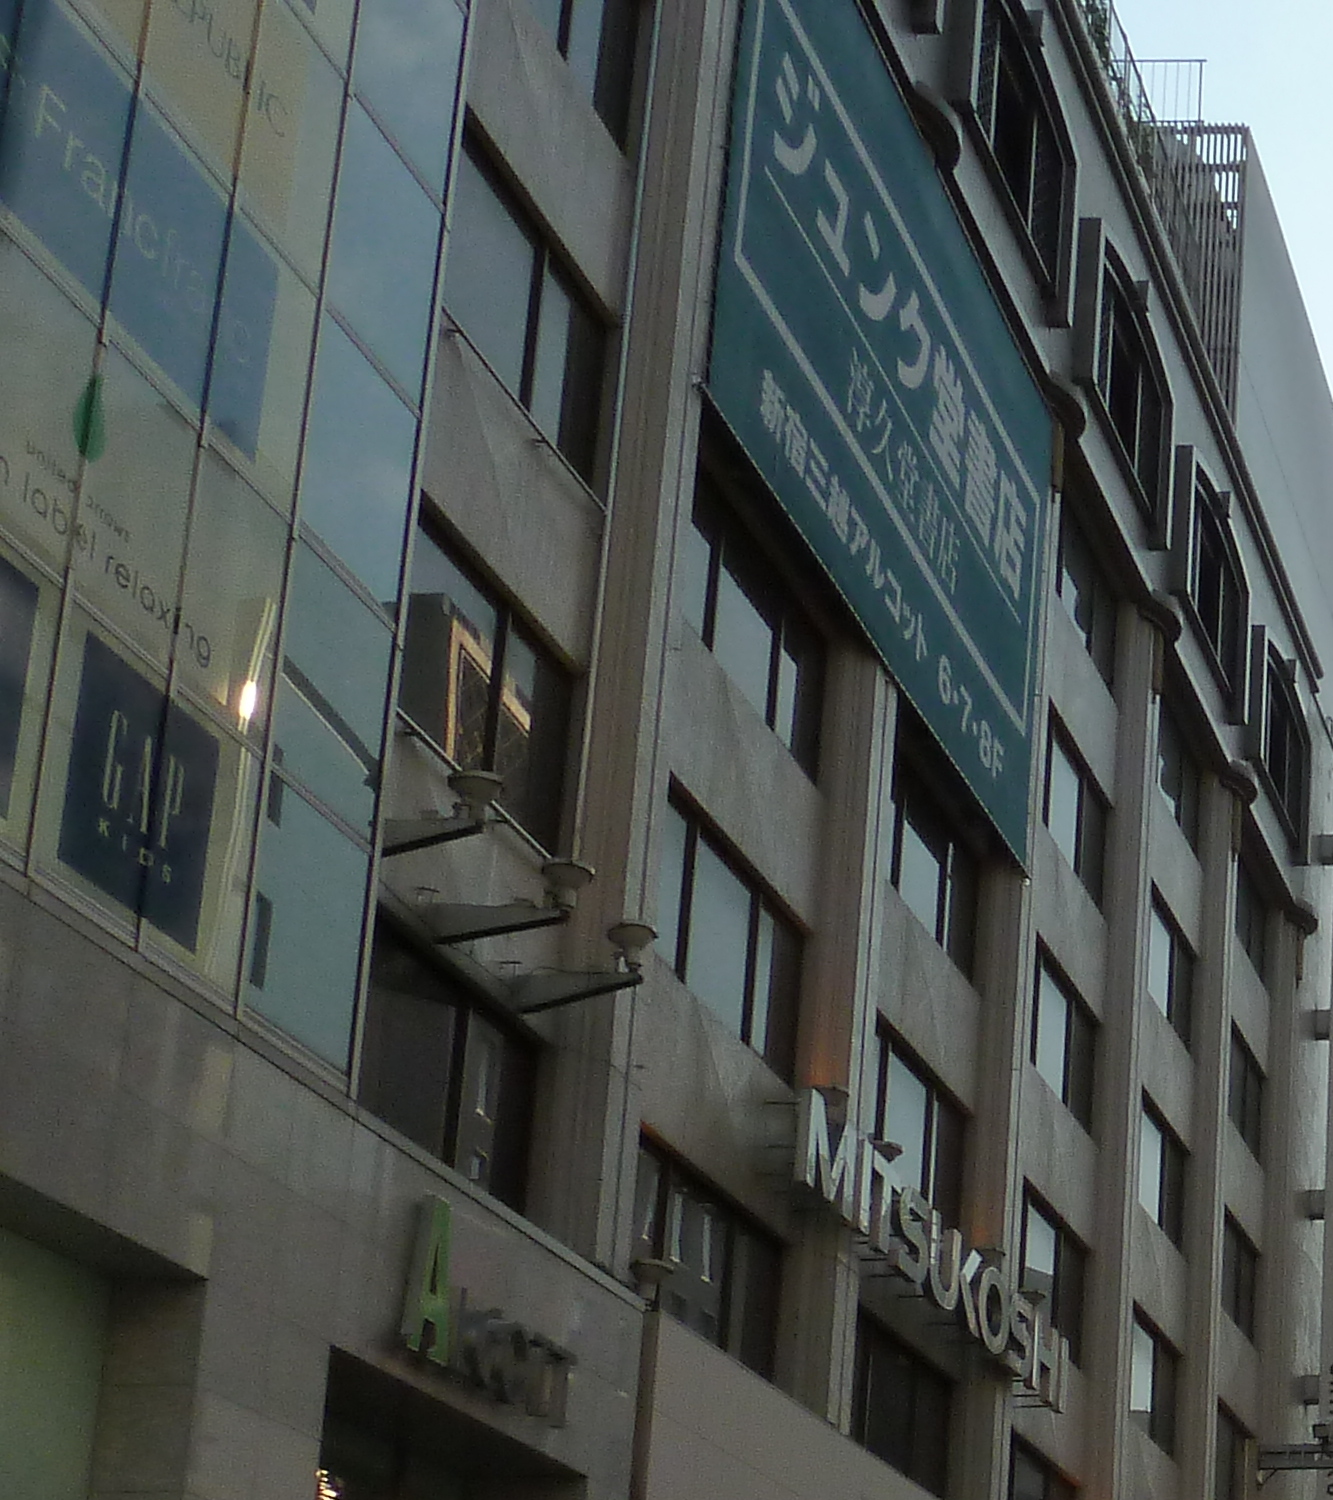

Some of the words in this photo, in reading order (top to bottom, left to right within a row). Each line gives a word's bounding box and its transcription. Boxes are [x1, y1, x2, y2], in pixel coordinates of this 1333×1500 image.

[773, 52, 1028, 601] ジュンク堂書店
[802, 1086, 1072, 1415] MITSUKOSHI
